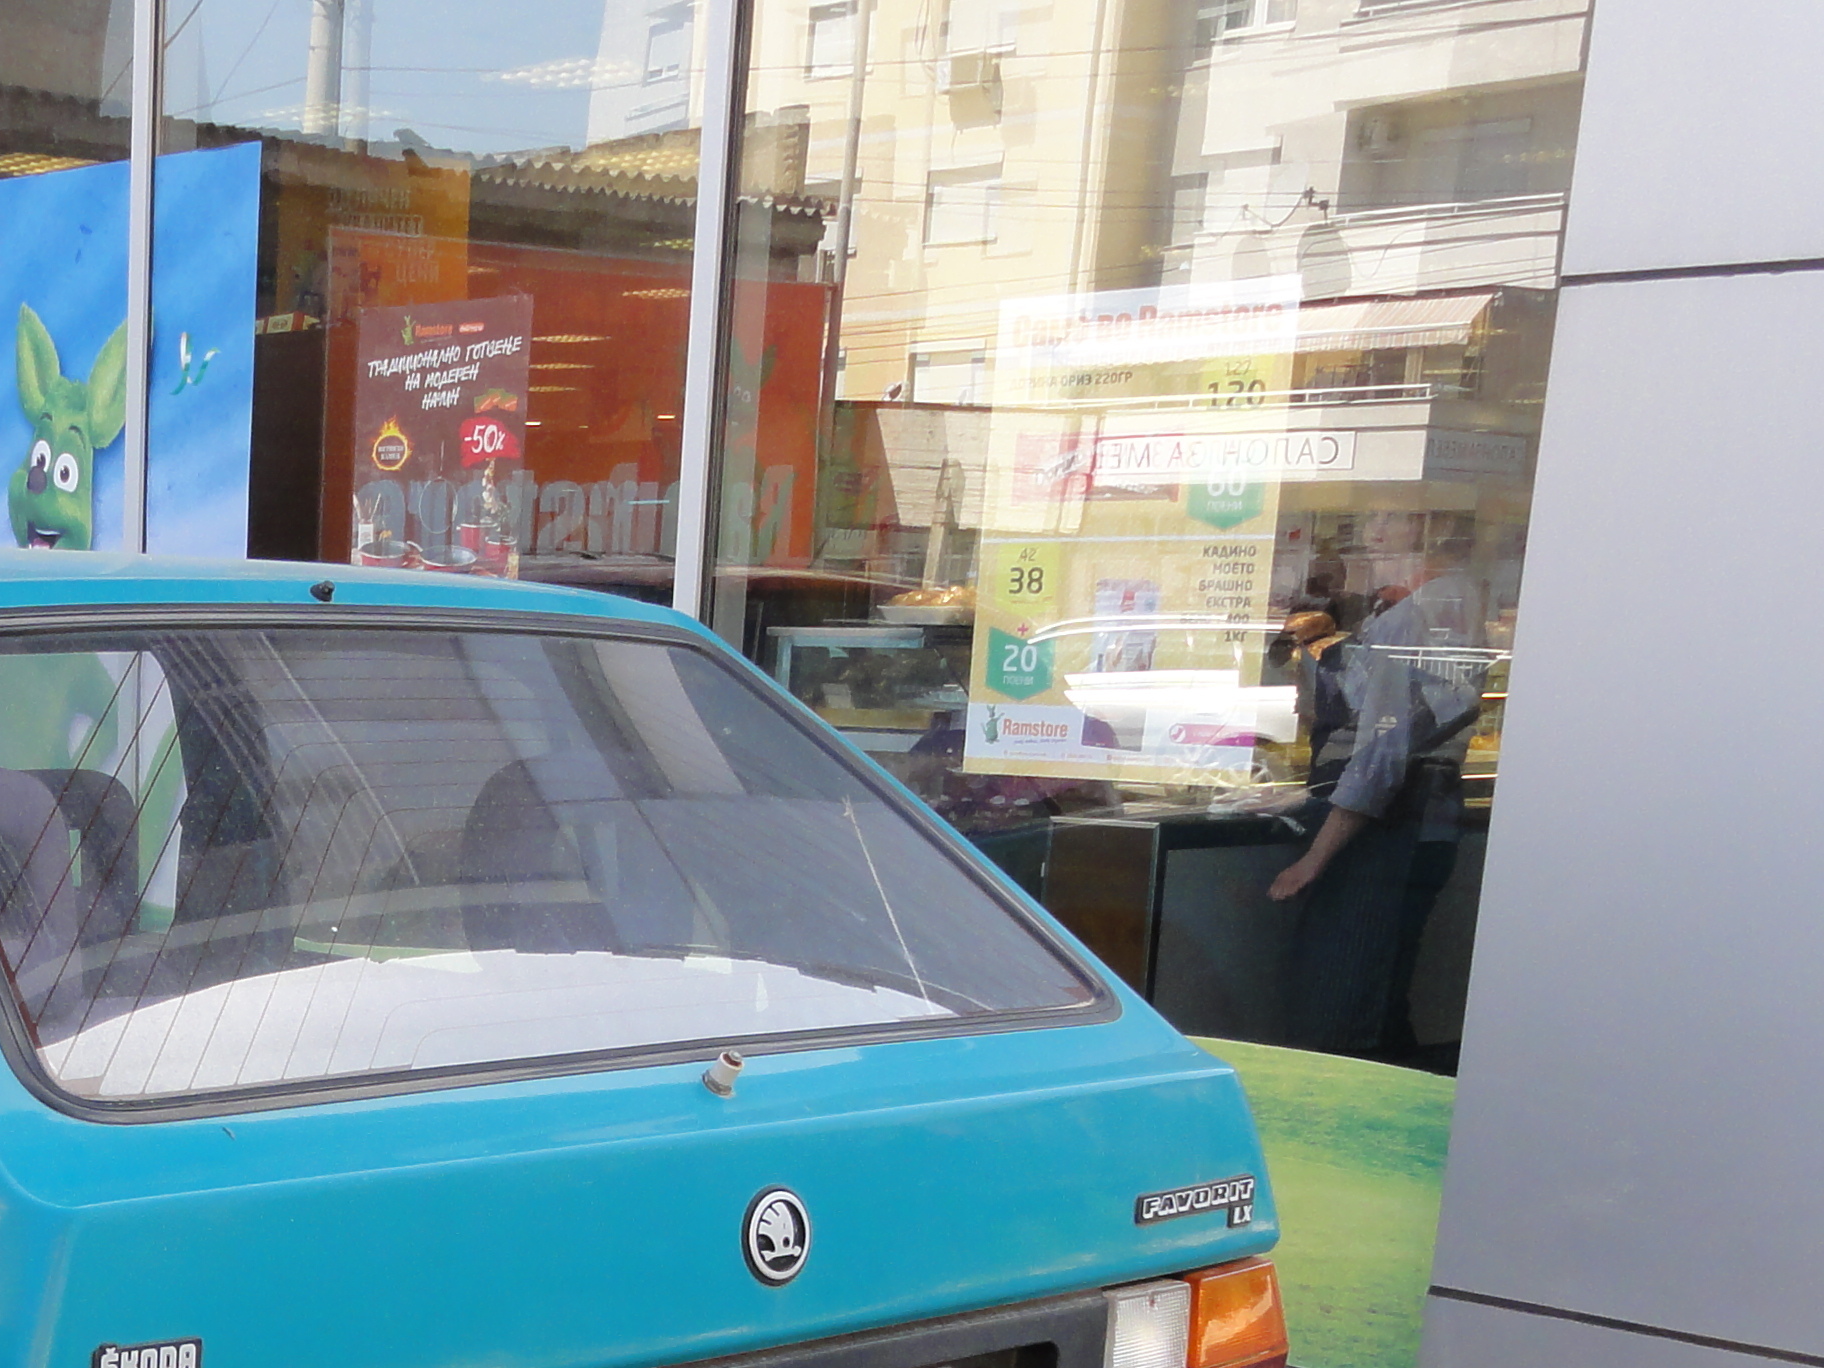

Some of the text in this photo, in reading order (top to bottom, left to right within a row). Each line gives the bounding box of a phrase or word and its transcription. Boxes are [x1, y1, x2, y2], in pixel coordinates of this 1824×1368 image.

[405, 371, 421, 391] НА
[1061, 374, 1092, 387] ОРИЗ
[464, 424, 506, 454] -50%
[1203, 545, 1257, 559] КАДИНО
[1008, 567, 1044, 594] 38
[1198, 579, 1253, 592] БРАШНО
[1206, 595, 1251, 609] ЕКСТРА
[1002, 644, 1038, 673] 20
[1002, 718, 1069, 739] Ramstore
[1142, 1178, 1255, 1220] FAVORIT
[1232, 1205, 1253, 1225] LX
